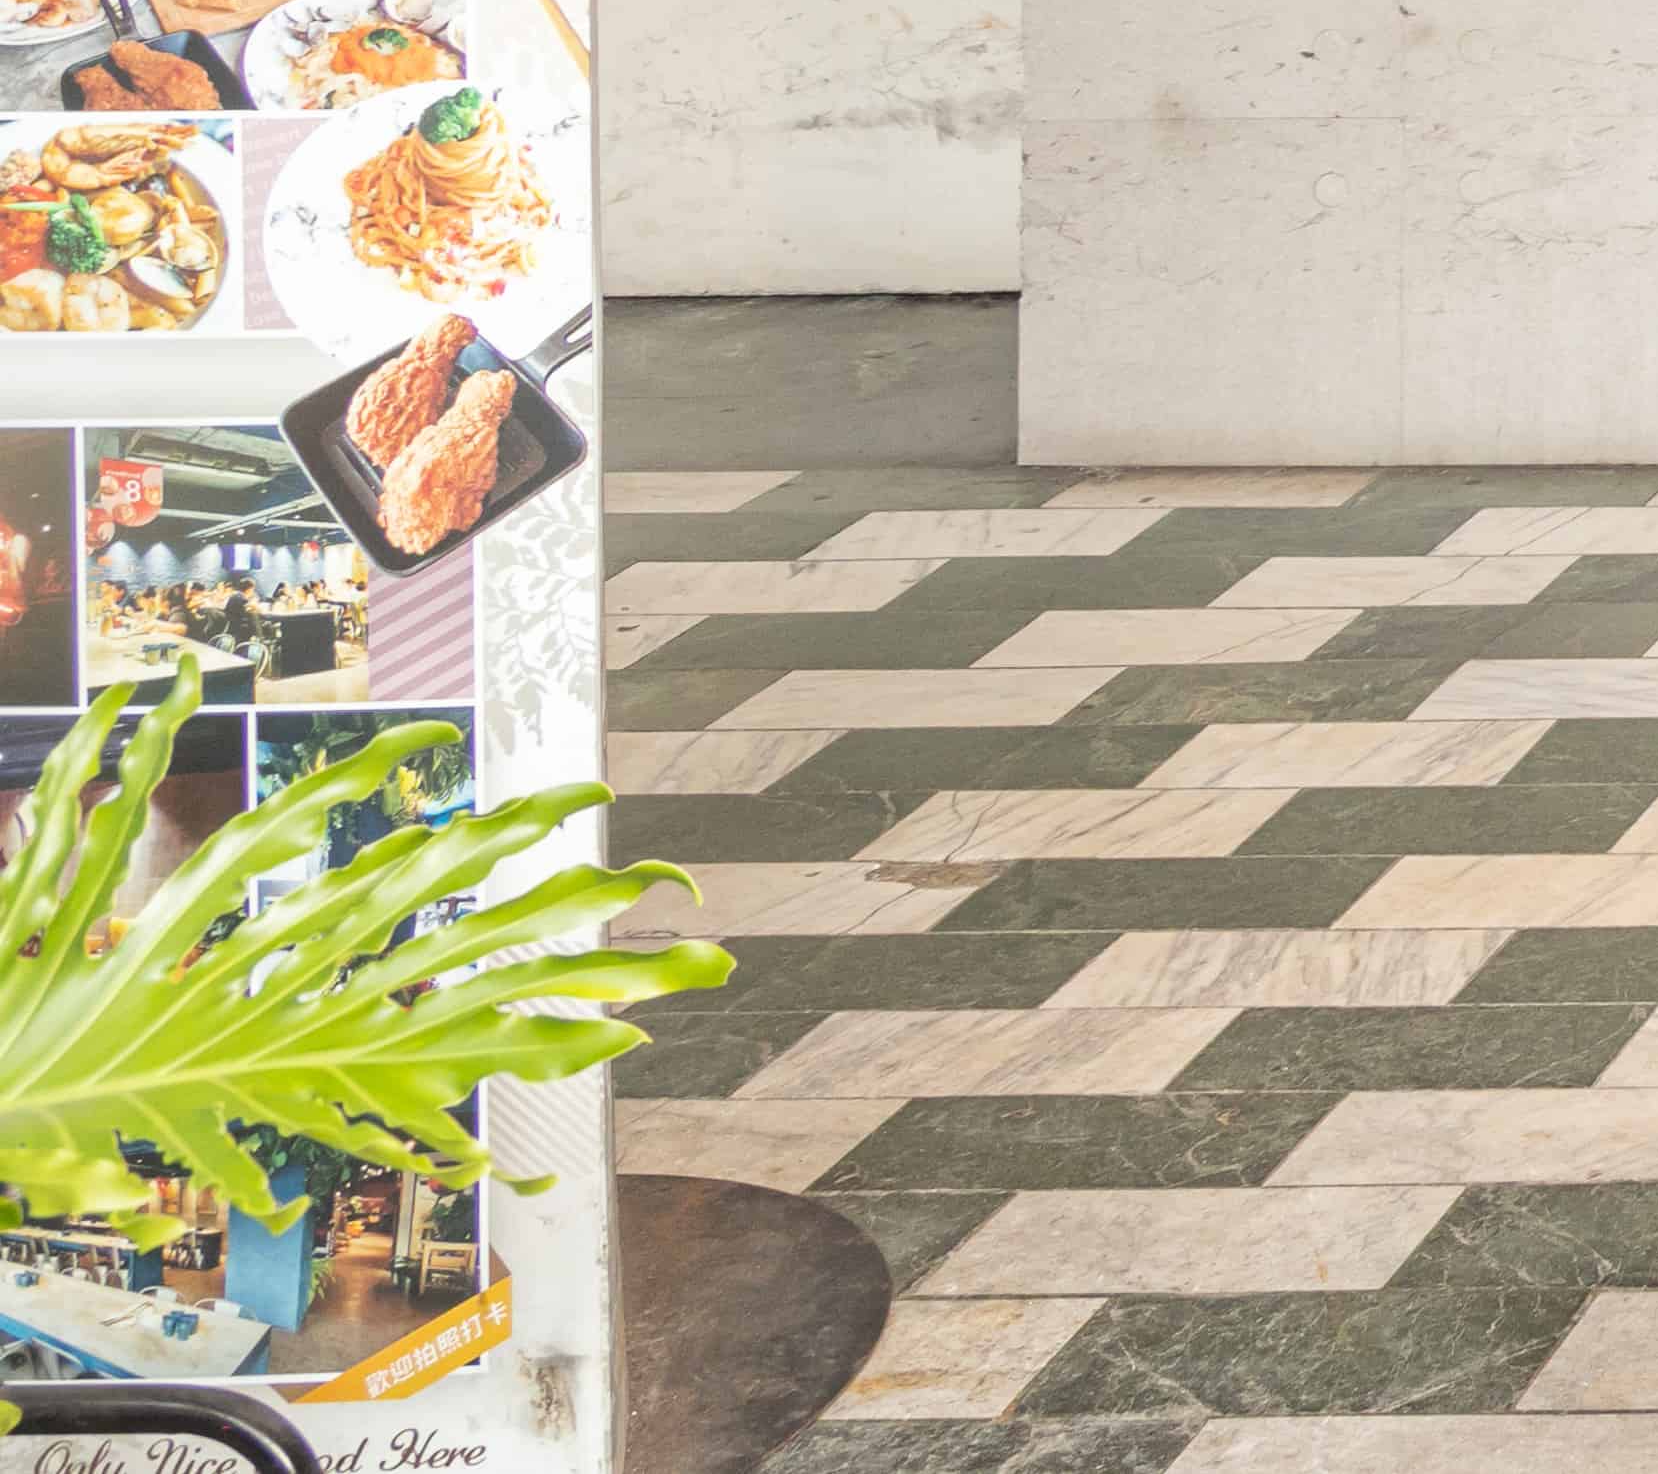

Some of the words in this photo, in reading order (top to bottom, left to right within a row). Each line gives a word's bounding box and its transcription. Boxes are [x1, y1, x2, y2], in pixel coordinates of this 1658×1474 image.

[364, 1300, 510, 1400] 歡迎拍照打卡
[34, 1439, 125, 1474] Only
[146, 1437, 237, 1474] Nice
[379, 1427, 488, 1472] Here
